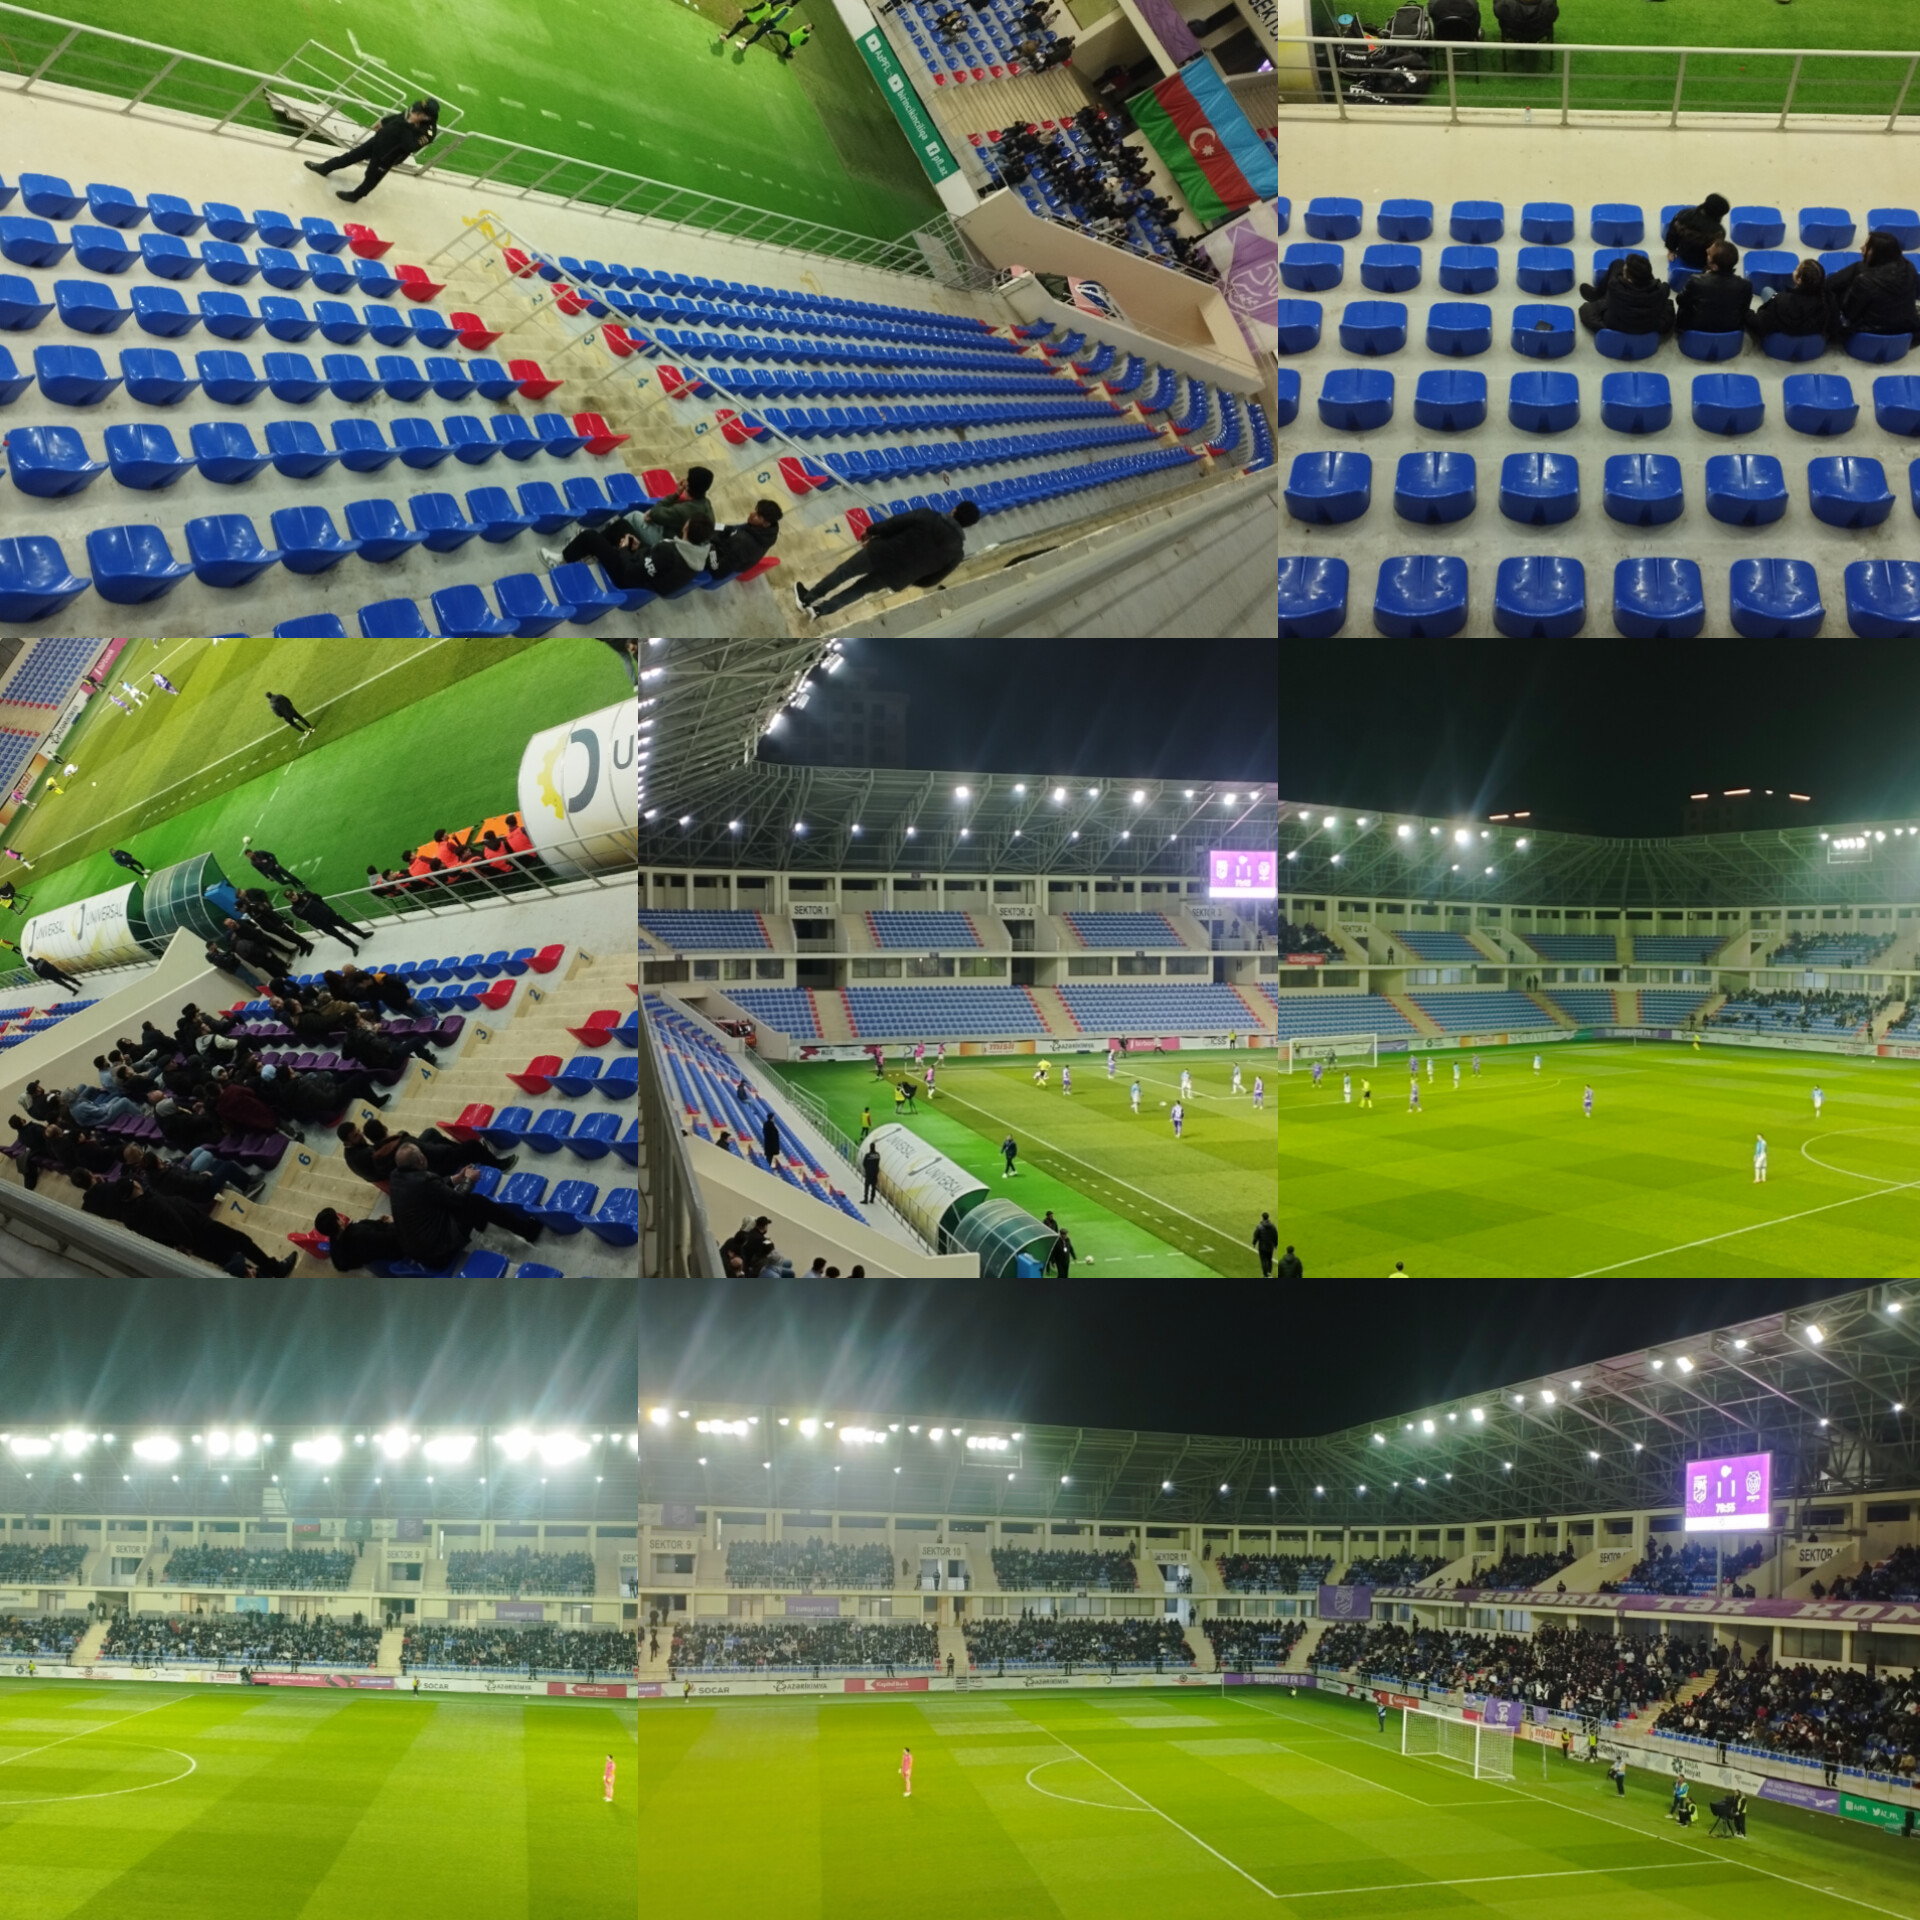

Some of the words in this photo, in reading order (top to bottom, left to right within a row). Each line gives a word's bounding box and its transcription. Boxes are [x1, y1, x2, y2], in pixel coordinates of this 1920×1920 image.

[584, 334, 595, 345] 3
[637, 378, 649, 388] 4
[695, 422, 708, 434] 5
[757, 472, 771, 484] 6
[825, 523, 841, 534] 7
[613, 734, 635, 770] U
[794, 905, 825, 915] SEKTOR
[1000, 907, 1027, 916] SEKTOR
[579, 952, 590, 961] 1
[529, 989, 541, 1001] 2
[476, 1028, 487, 1040] 3
[421, 1067, 432, 1080] 4
[362, 1108, 374, 1120] 5
[298, 1153, 311, 1166] 6
[230, 1201, 244, 1214] 7
[116, 1545, 141, 1554] SEKTOR
[649, 1540, 683, 1549] SEKTOR
[686, 1540, 692, 1550] 9
[387, 1551, 413, 1559] SEKTOR
[922, 1547, 951, 1556] SEKTOR
[1800, 1548, 1833, 1561] SEKTOR
